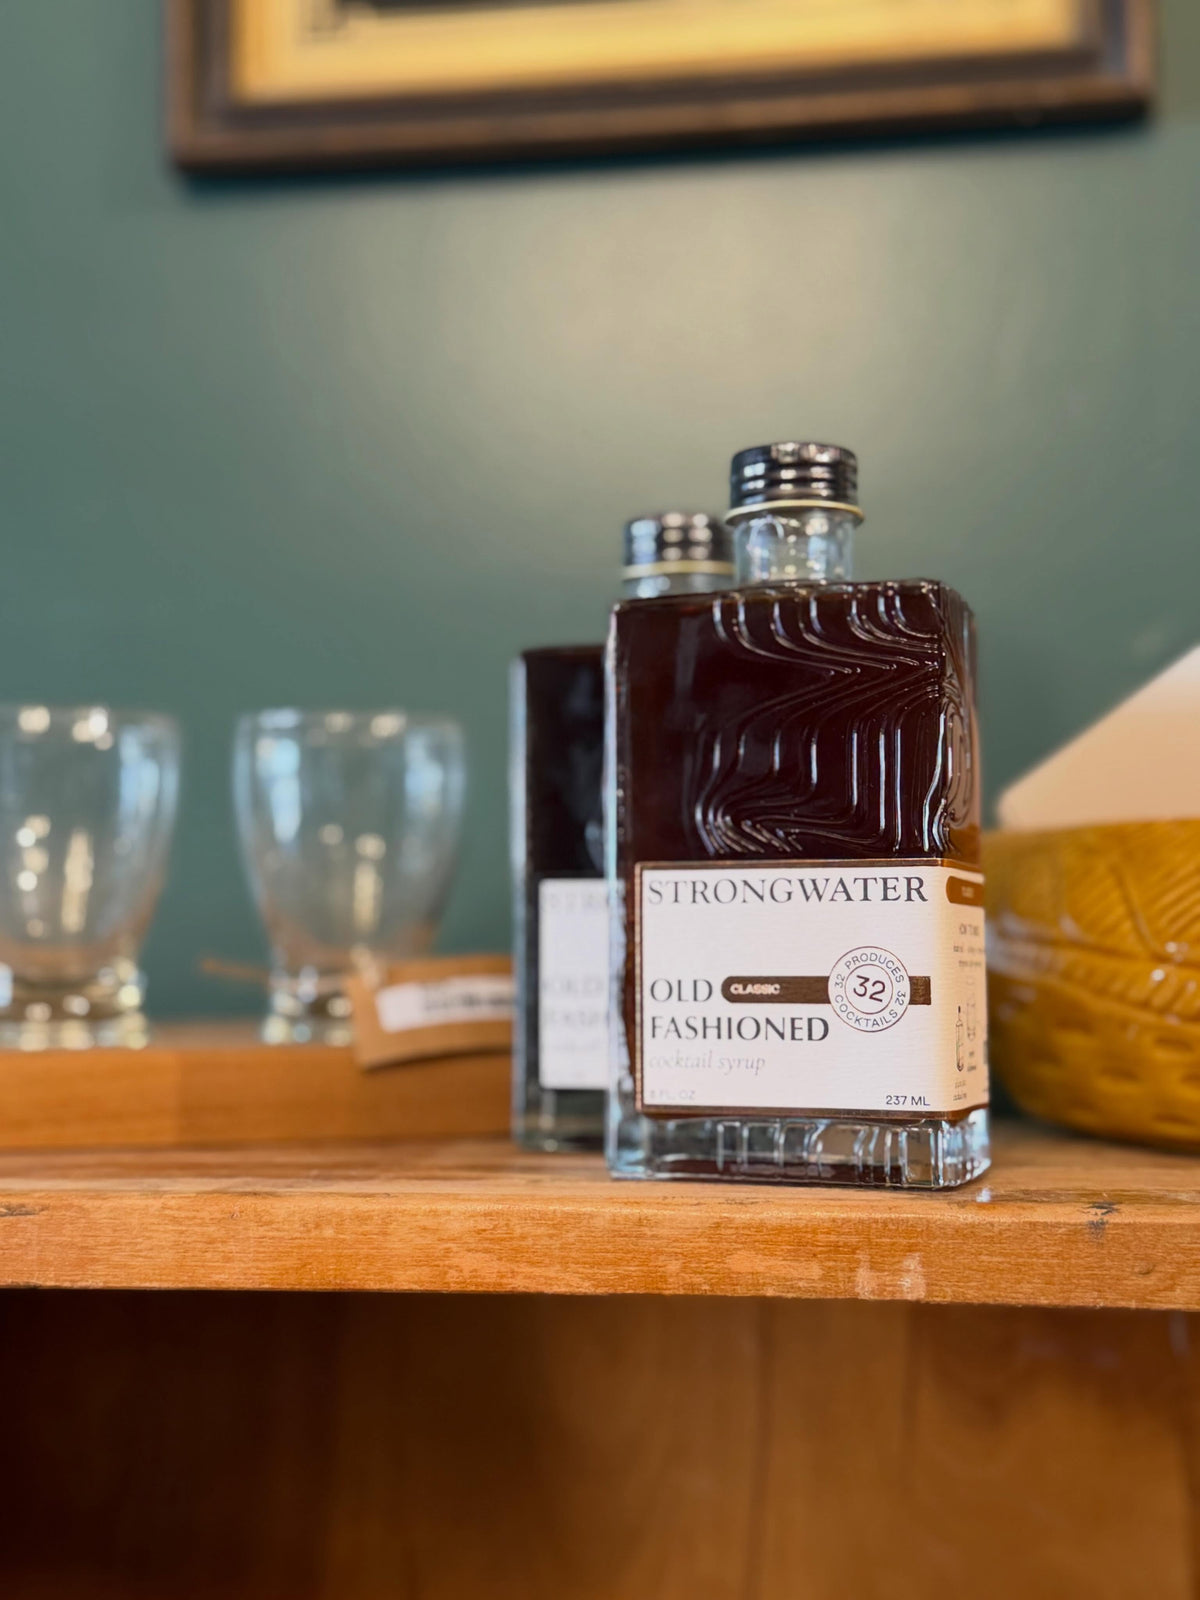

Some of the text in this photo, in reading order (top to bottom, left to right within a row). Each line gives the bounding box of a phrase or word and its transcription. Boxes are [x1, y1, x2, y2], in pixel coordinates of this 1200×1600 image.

[648, 876, 928, 904] STRONGWATER
[844, 952, 905, 983] PRODUCES
[650, 978, 713, 1003] OLD
[729, 983, 781, 995] CLASSIC
[834, 973, 845, 988] 32
[853, 975, 886, 1003] 32
[894, 990, 906, 1006] 32
[834, 994, 898, 1028] COCKTAILS
[650, 1016, 829, 1041] FASHIONED
[648, 1048, 712, 1069] cocktail
[717, 1057, 766, 1076] syrup
[885, 1095, 931, 1107] 237 ML
